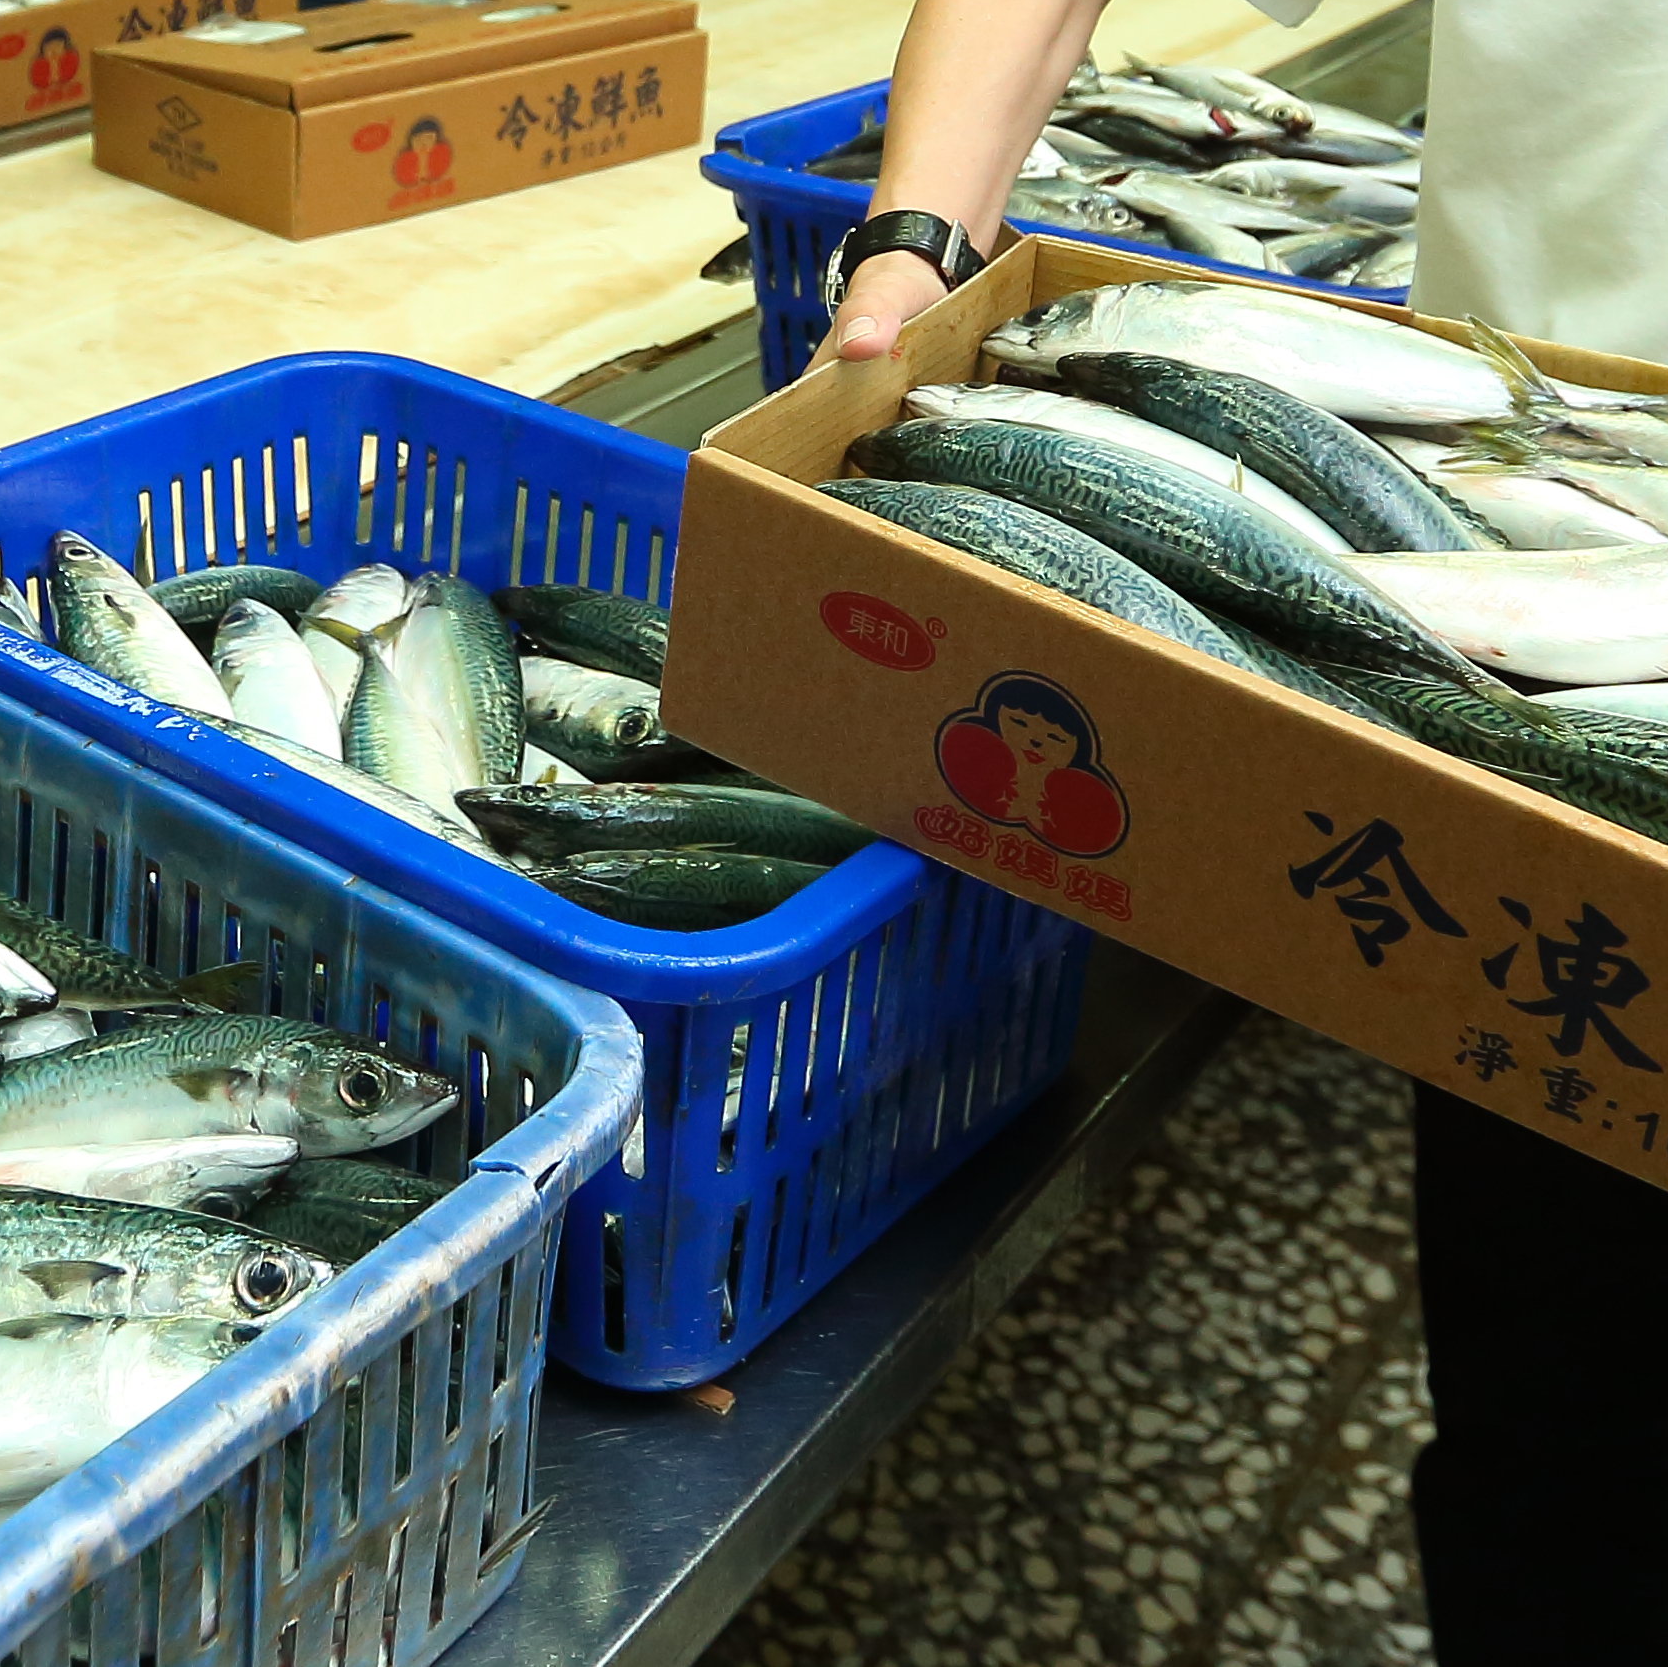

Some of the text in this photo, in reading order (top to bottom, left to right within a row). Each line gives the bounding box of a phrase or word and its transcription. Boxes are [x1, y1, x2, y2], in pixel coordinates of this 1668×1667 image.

[496, 66, 664, 151] 冷凍鮮魚
[845, 607, 909, 657] 東和
[913, 803, 1132, 923] 好媽媽
